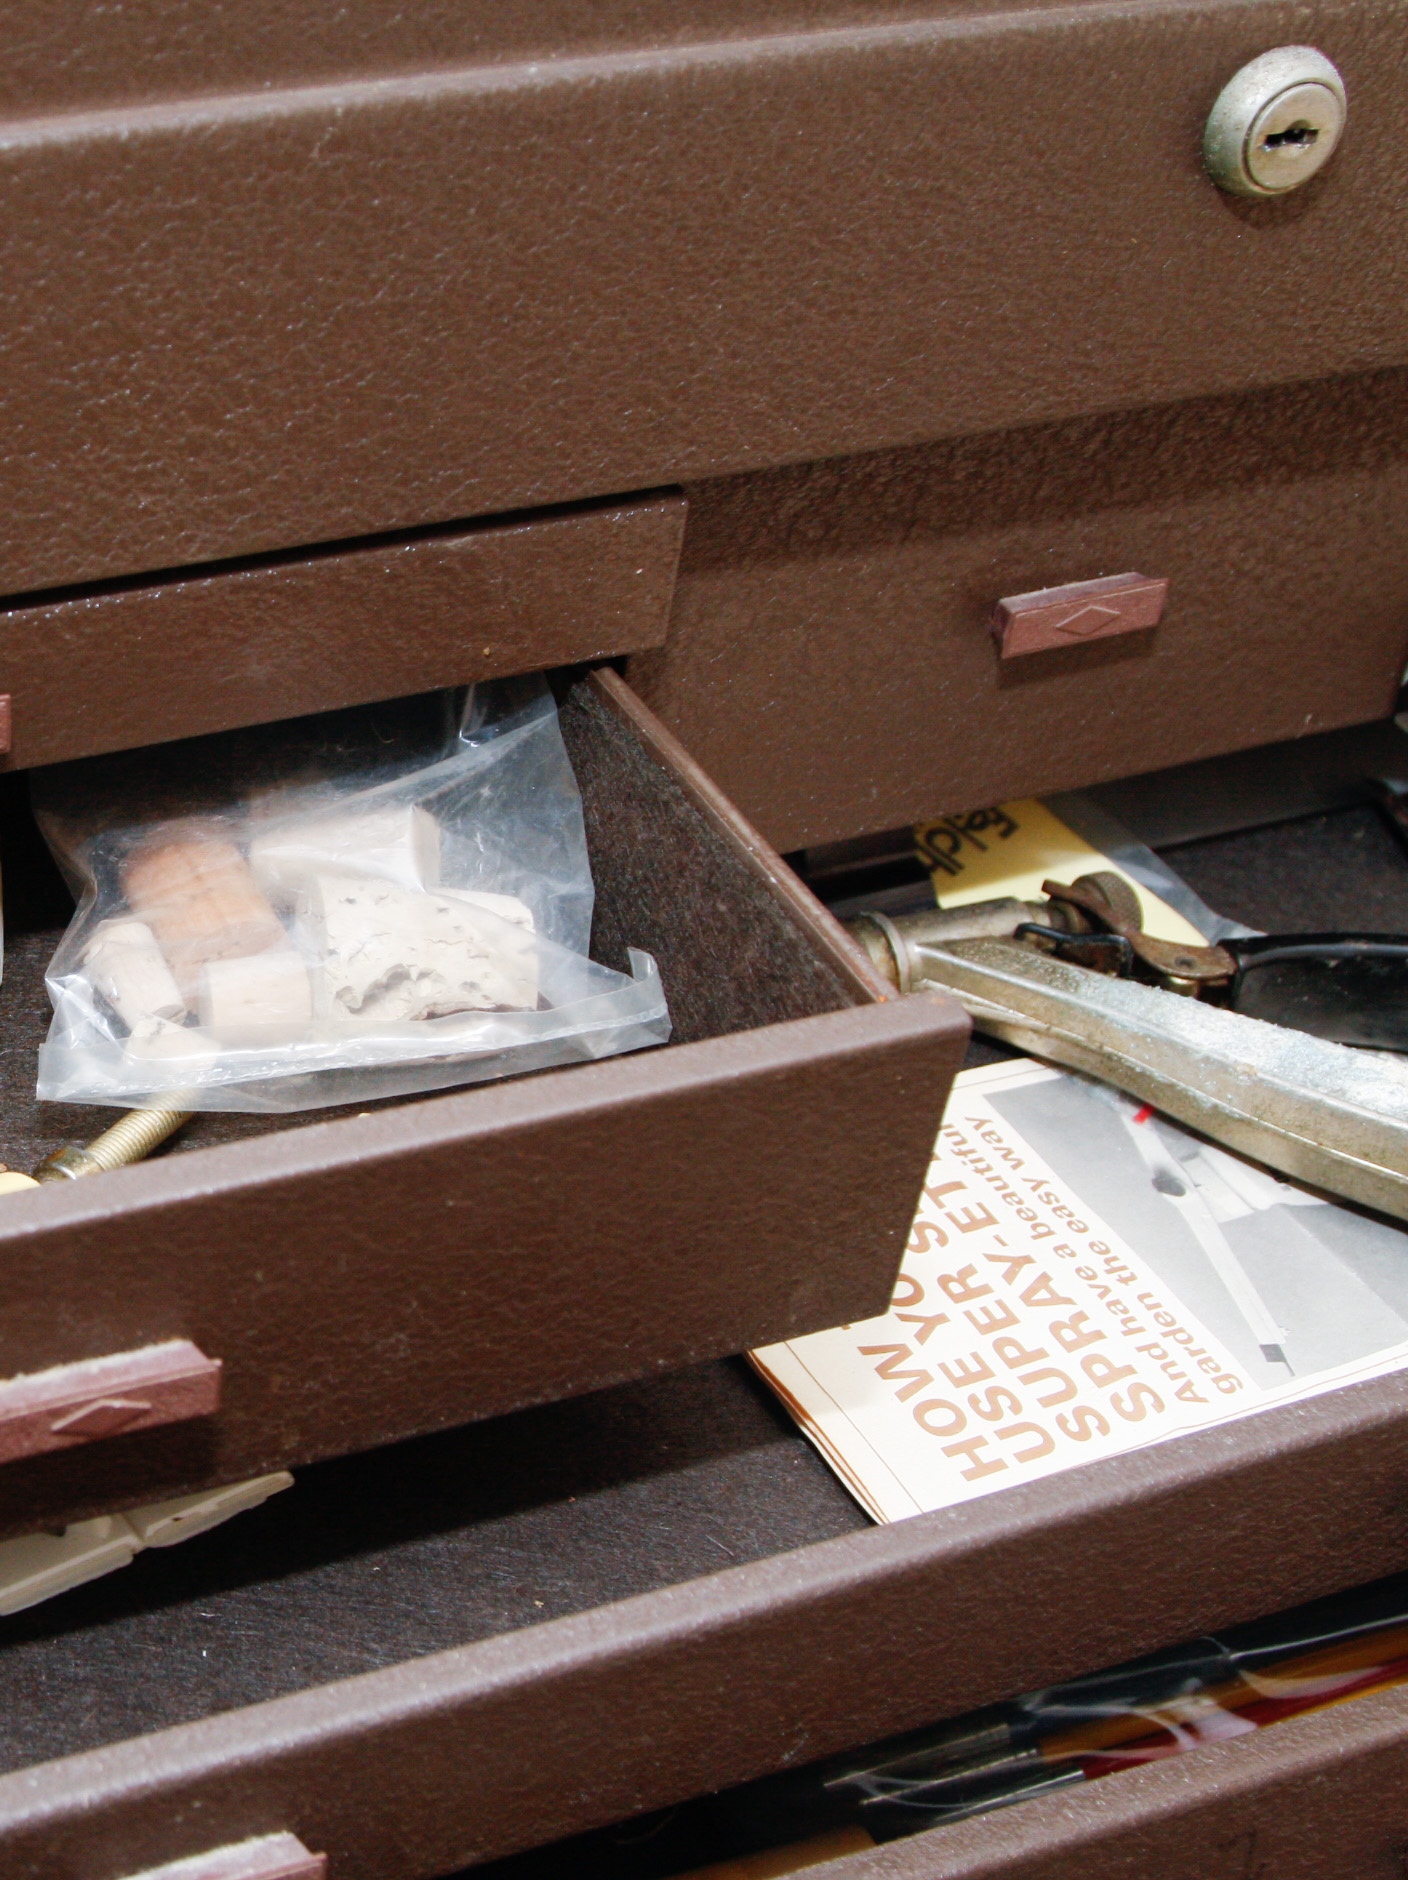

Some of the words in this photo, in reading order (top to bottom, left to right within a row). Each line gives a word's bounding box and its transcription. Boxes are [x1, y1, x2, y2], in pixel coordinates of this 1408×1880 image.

[964, 1116, 1026, 1171] way
[1020, 1177, 1090, 1234] easy
[923, 1152, 1166, 1423] SPRAY-ET
[1052, 1243, 1078, 1259] a
[1088, 1240, 1138, 1286] the
[891, 1272, 951, 1346] YO
[1074, 1265, 1147, 1337] have
[936, 1262, 1111, 1442] SUPER
[1134, 1341, 1210, 1404] And
[1136, 1291, 1244, 1395] garden
[856, 1342, 1010, 1482] HOW
[936, 1351, 1056, 1464] USE
